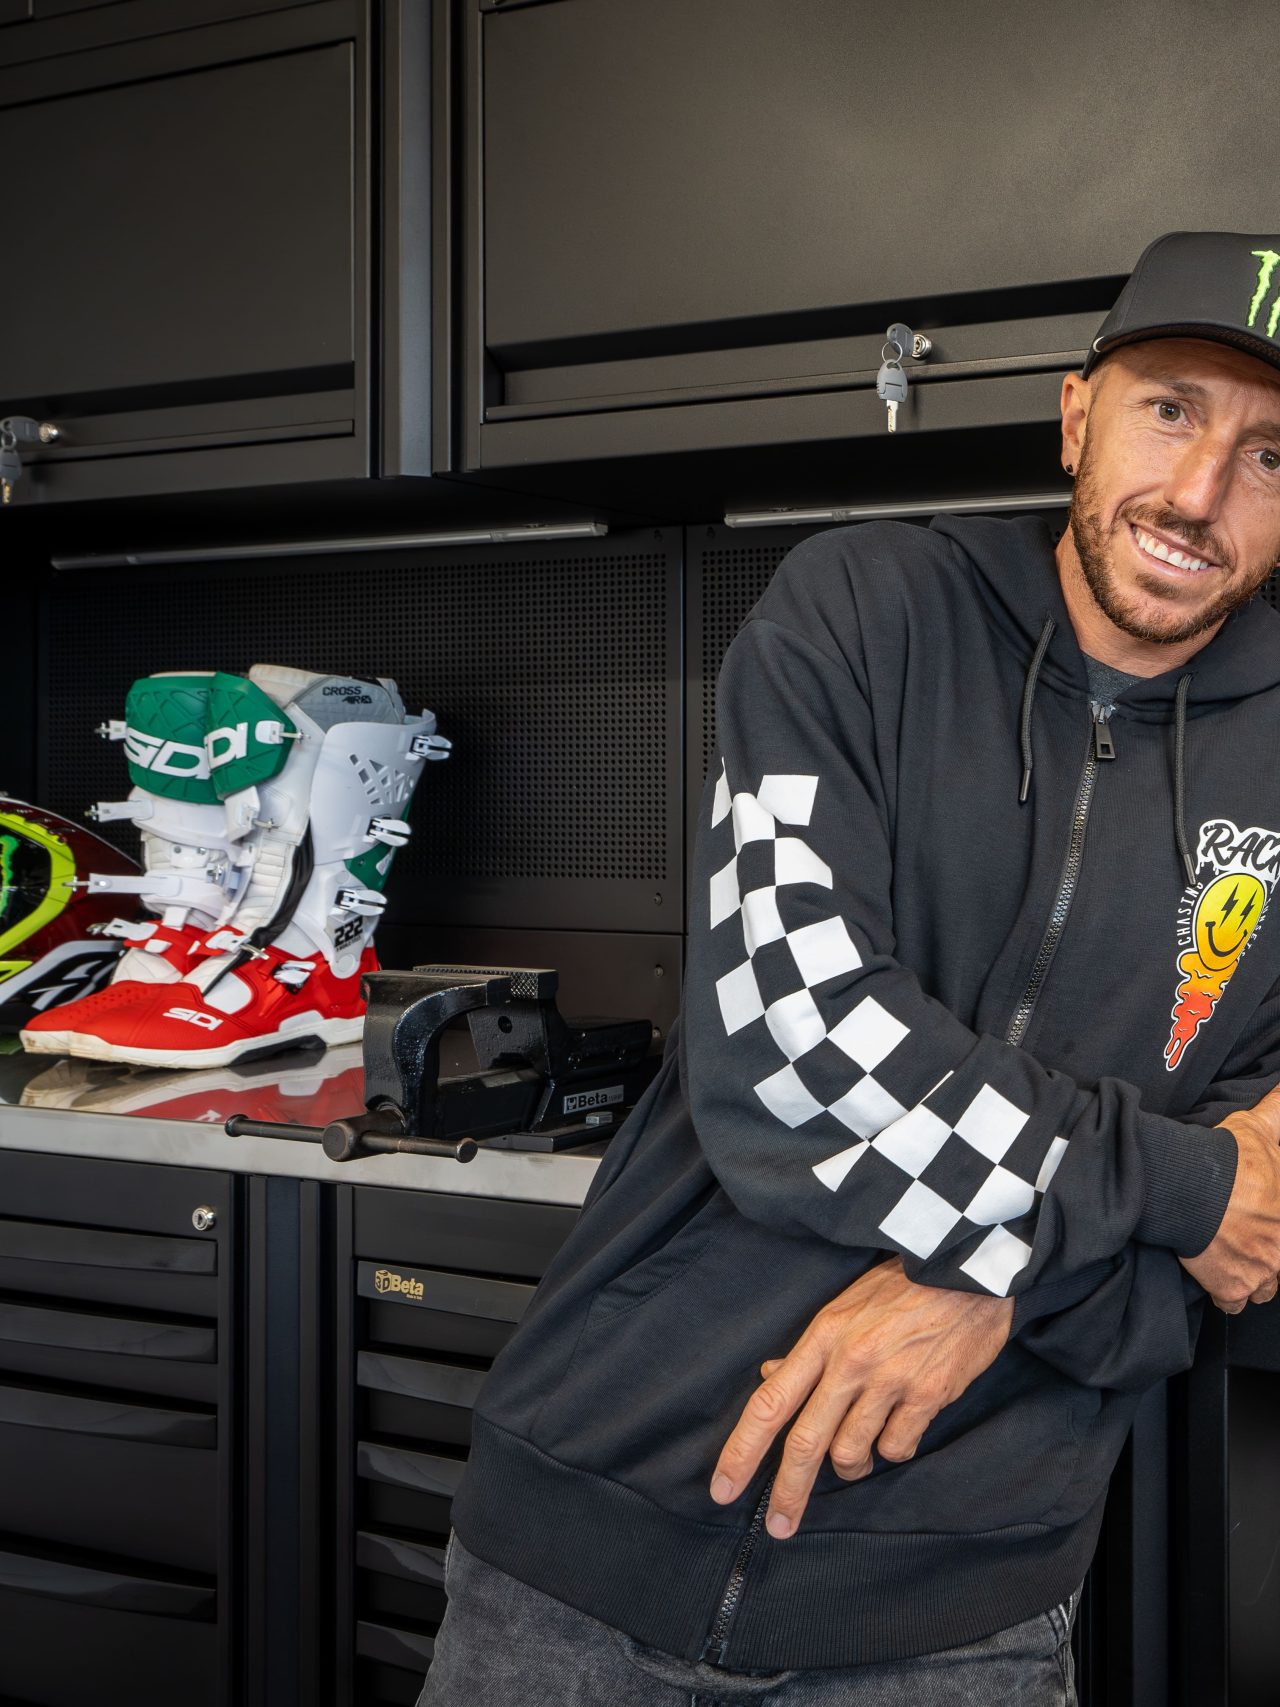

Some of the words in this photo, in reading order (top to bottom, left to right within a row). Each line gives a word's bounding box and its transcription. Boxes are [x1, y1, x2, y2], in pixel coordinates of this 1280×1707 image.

[322, 686, 362, 696] CROSS
[334, 915, 363, 949] 222
[577, 1092, 608, 1108] Beta
[391, 1274, 424, 1296] Beta
